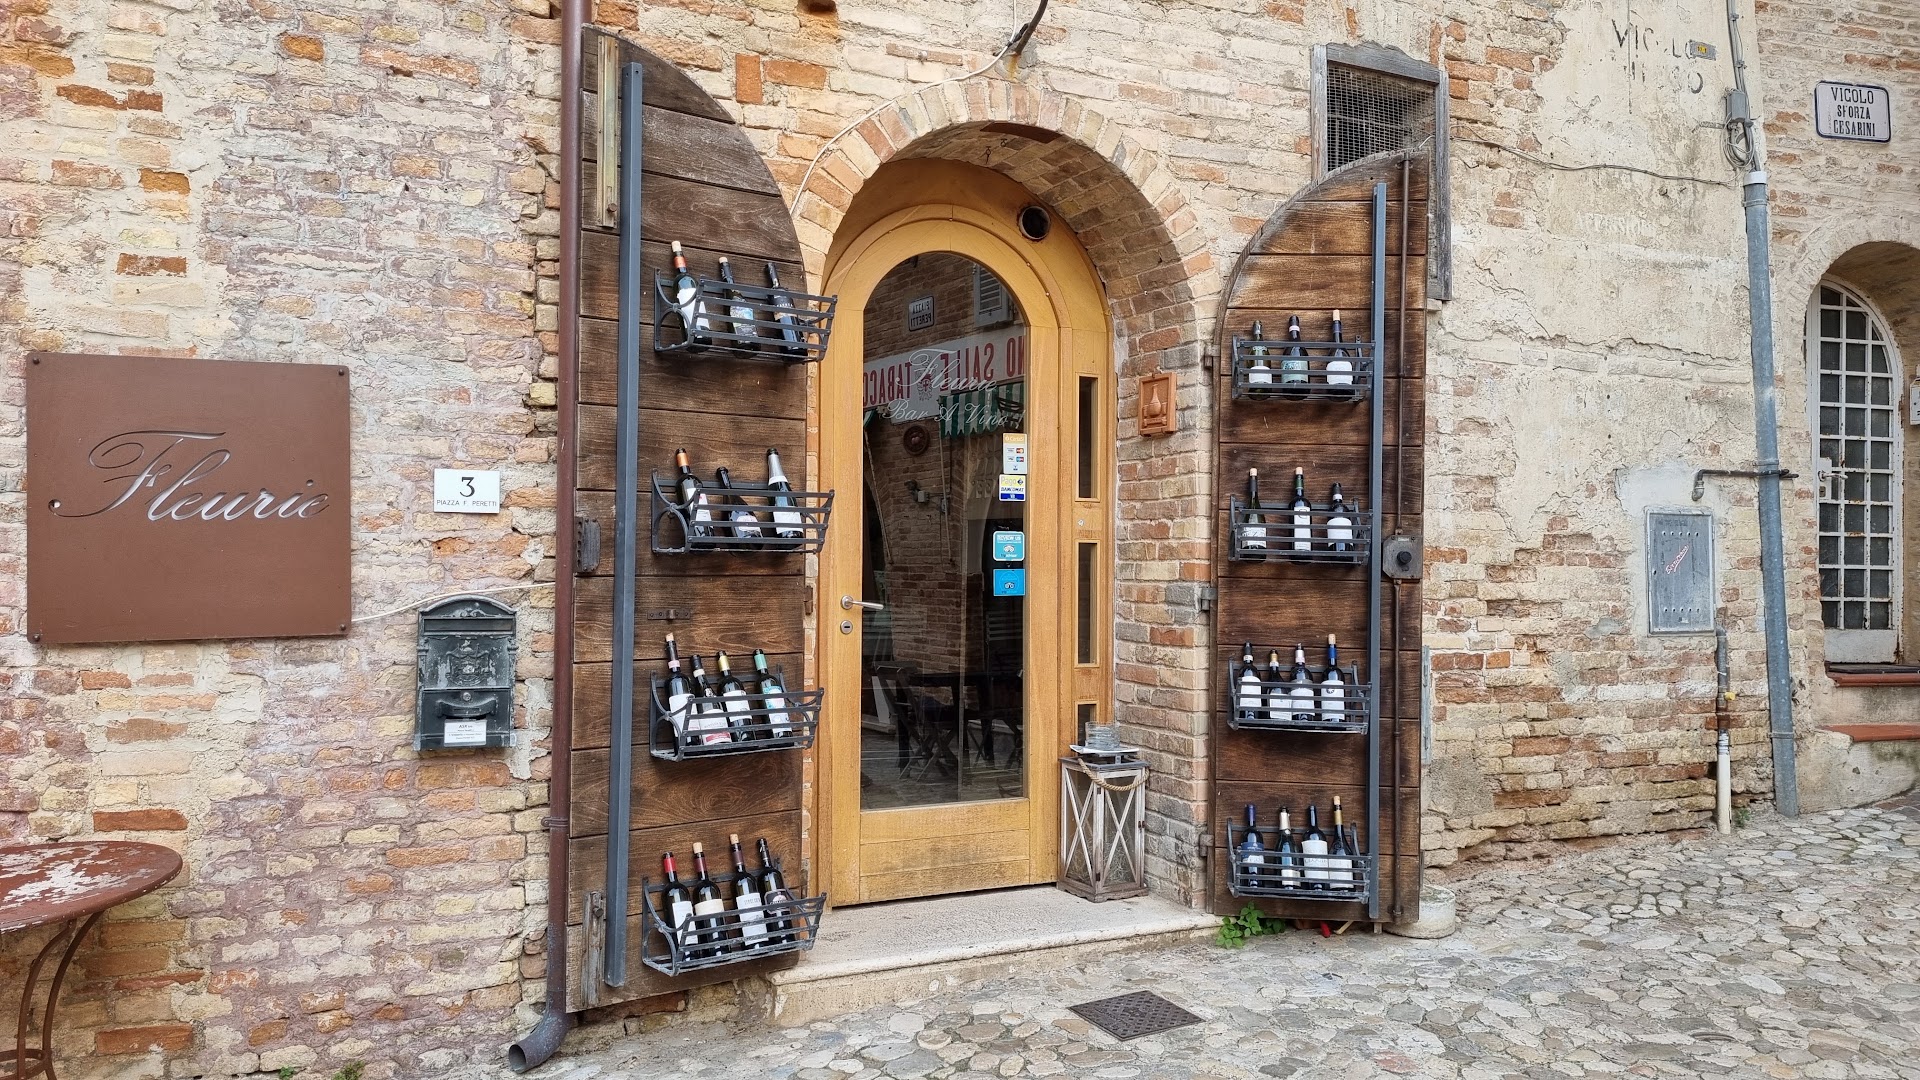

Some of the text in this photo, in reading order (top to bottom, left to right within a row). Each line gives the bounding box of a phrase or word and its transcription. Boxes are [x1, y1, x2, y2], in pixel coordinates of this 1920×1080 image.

[1830, 86, 1874, 104] VICOLO
[1837, 104, 1871, 120] SFORZA
[1833, 119, 1875, 137] CESARINI
[895, 348, 997, 392] Fleurie
[882, 398, 1009, 427] Bar A Vino
[47, 429, 329, 522] Fleurie
[1001, 476, 1016, 486] Pago
[459, 476, 475, 497] 3
